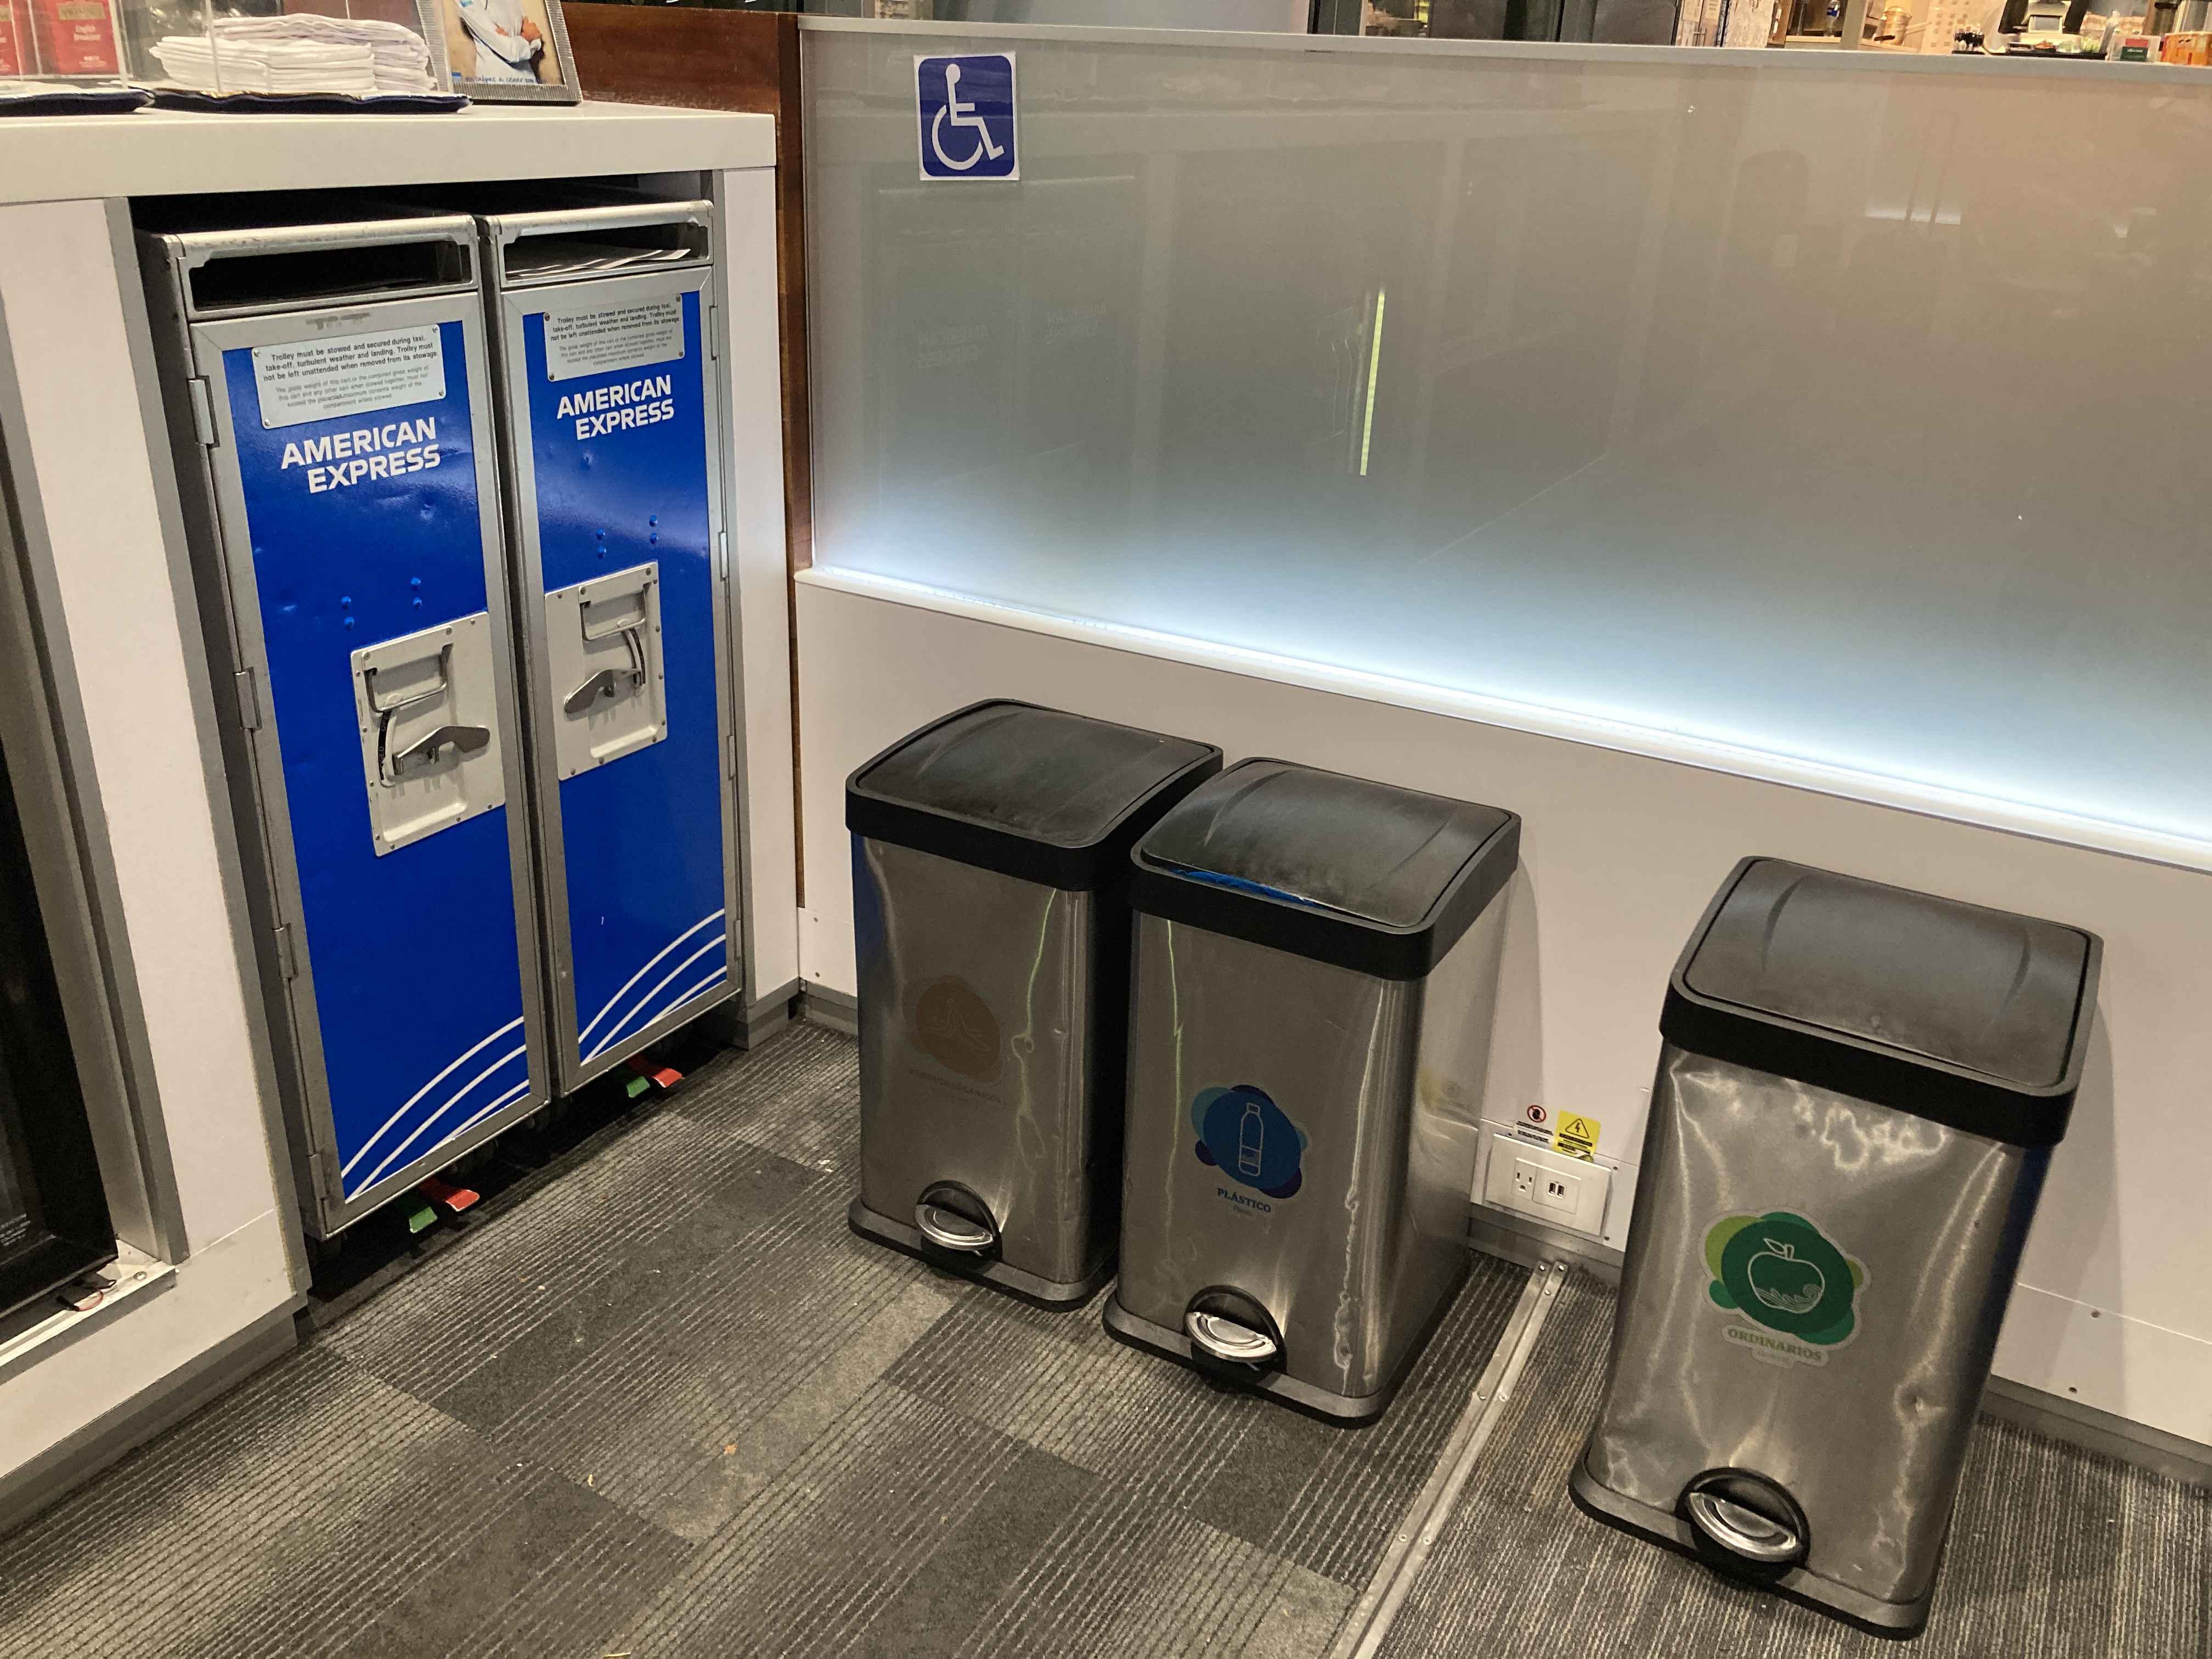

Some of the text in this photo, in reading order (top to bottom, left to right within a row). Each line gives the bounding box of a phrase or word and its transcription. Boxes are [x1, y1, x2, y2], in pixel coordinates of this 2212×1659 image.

[557, 317, 574, 325] Trolley
[646, 304, 660, 312] during
[575, 321, 597, 329] turbulent
[579, 328, 606, 337] unattended
[271, 352, 295, 362] Trolley
[327, 345, 351, 353] stowed
[366, 340, 391, 348] secured
[392, 337, 411, 346] during
[297, 357, 326, 367] turbulent
[329, 353, 355, 362] weather
[397, 345, 417, 354] Trolley
[302, 365, 338, 376] unattended
[360, 358, 386, 367] removed
[557, 374, 672, 420] AMERICAN
[575, 398, 674, 441] EXPRESS
[280, 417, 437, 470] AMERICAN
[307, 444, 441, 494] EXPRESS
[1216, 1187, 1271, 1213] PLÁSTICO
[1728, 1328, 1822, 1361] ORDINARIOS
